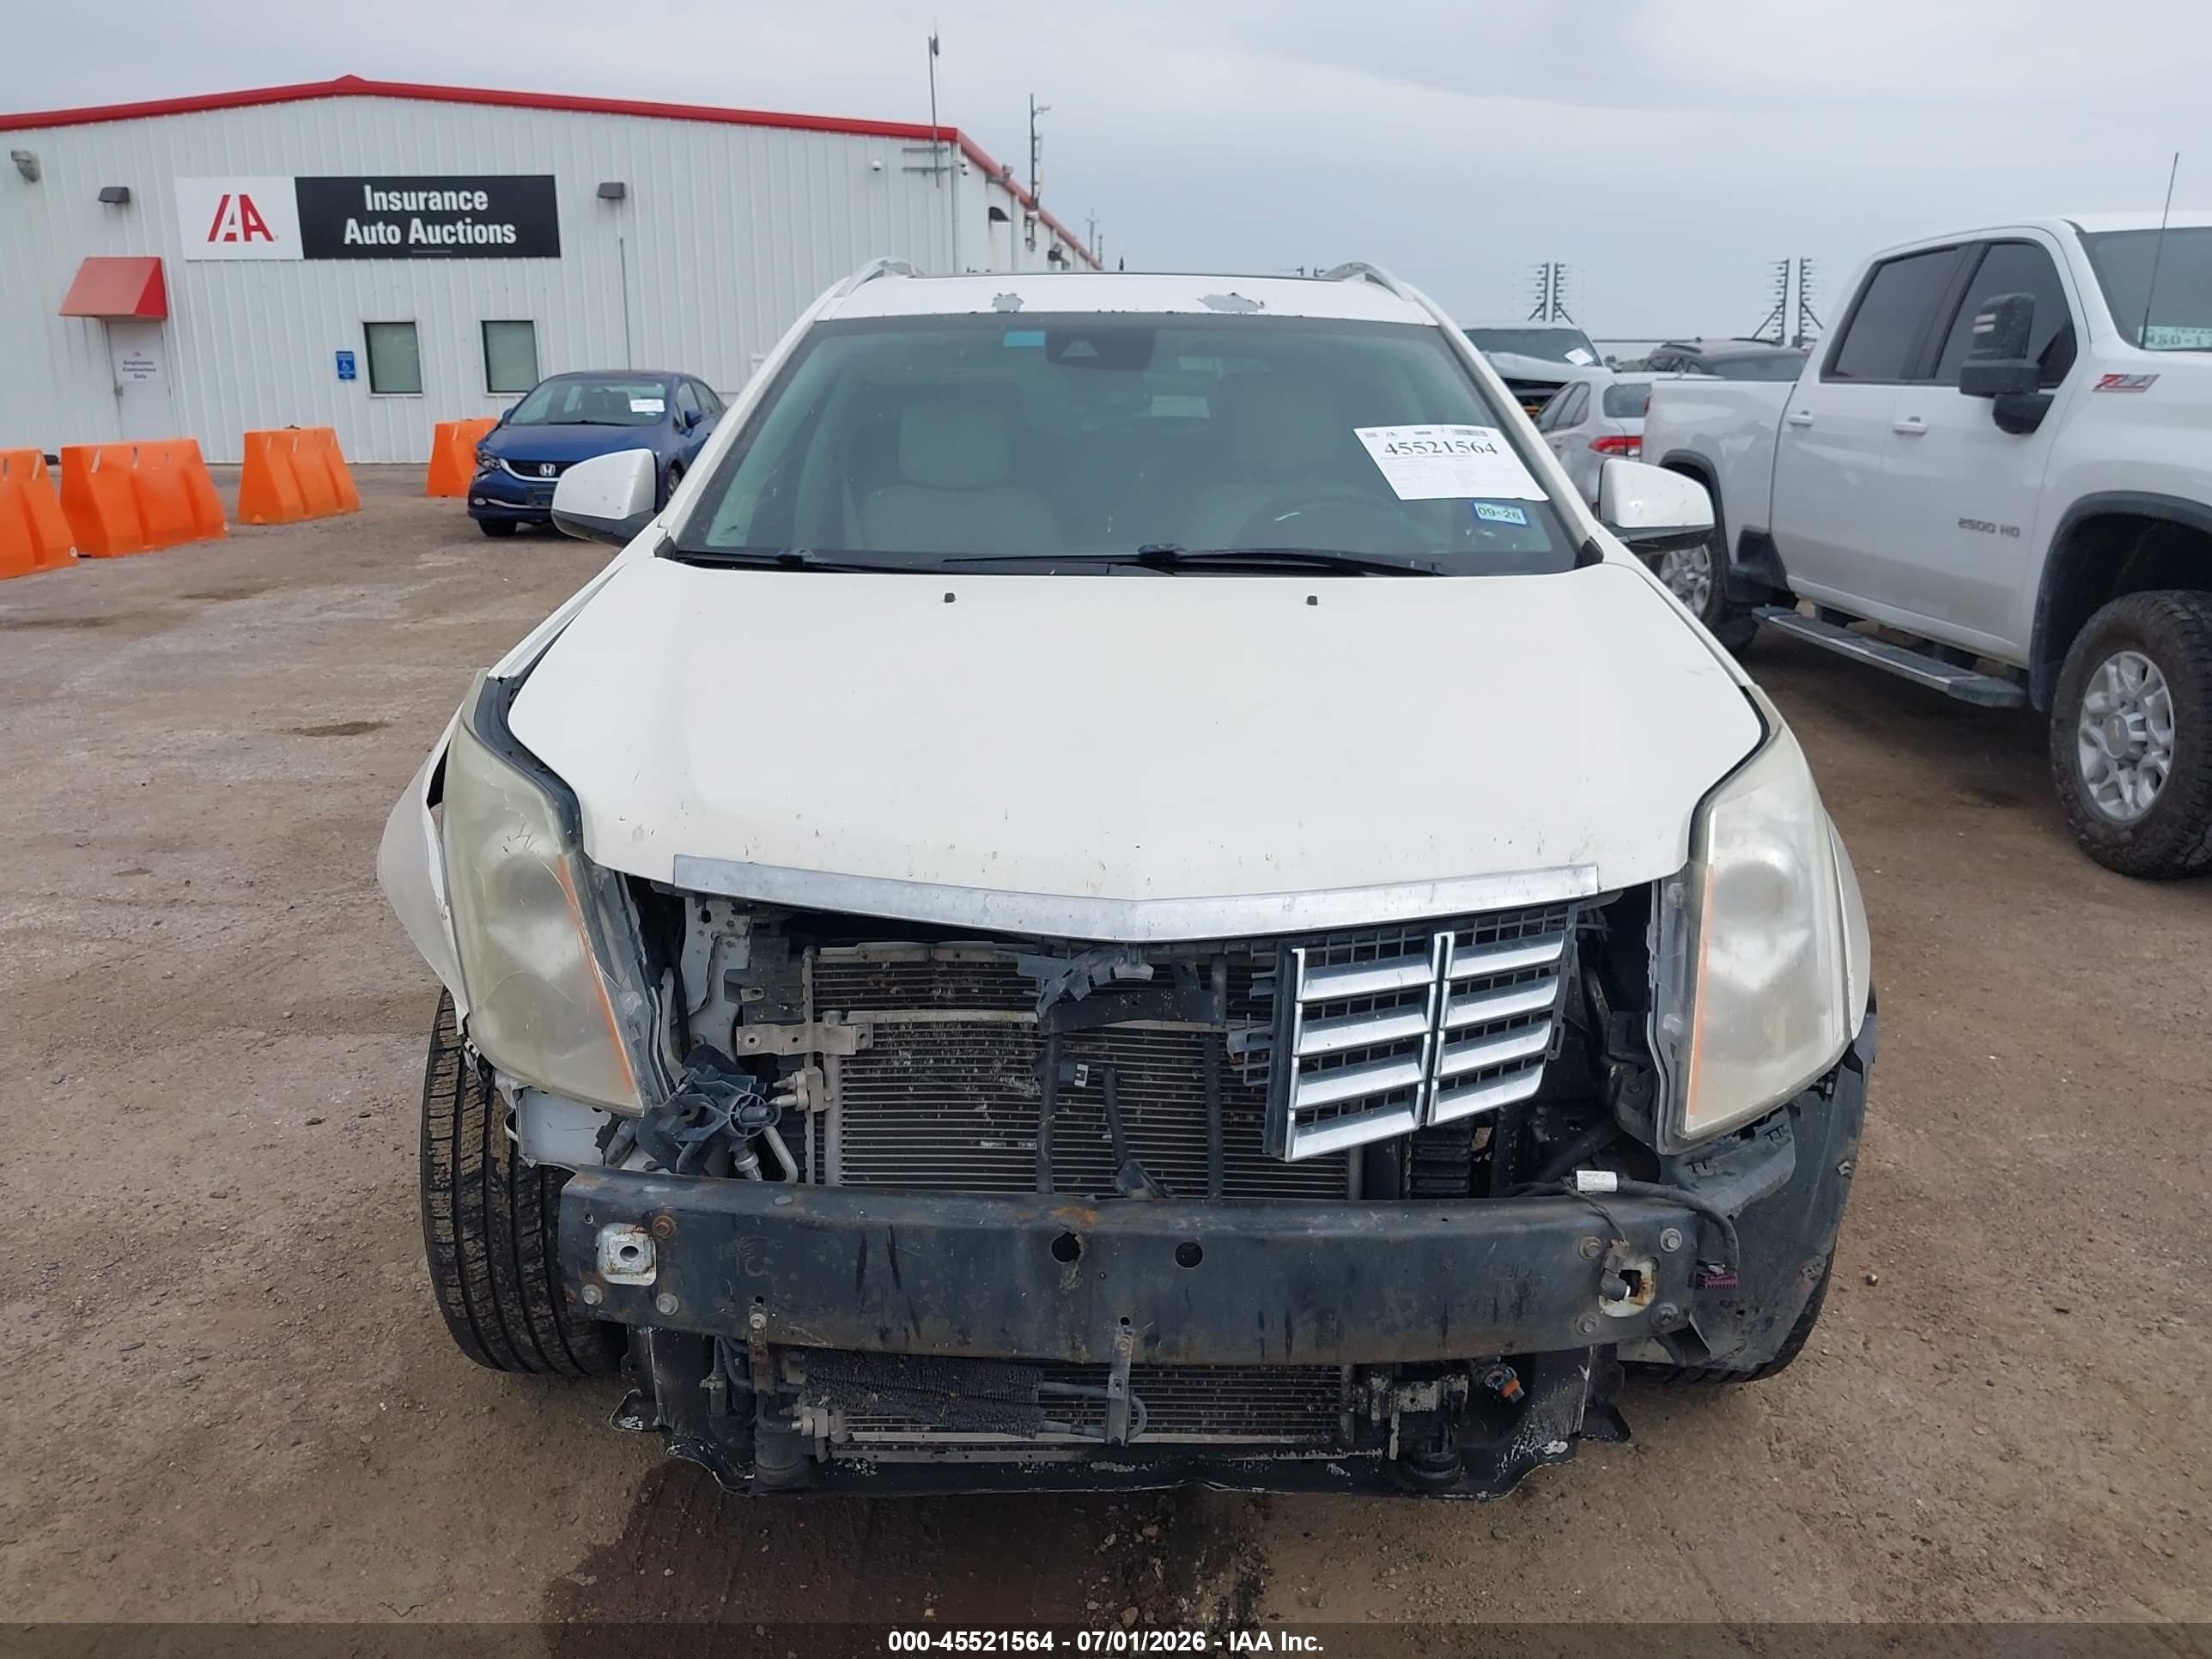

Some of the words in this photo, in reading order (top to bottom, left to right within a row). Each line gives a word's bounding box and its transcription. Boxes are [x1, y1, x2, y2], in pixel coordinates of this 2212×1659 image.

[364, 185, 489, 211] Insurance
[344, 218, 401, 245] Auto
[409, 217, 517, 245] Auctions
[1383, 441, 1498, 455] 45521564
[1957, 517, 1996, 534] 2500
[1999, 524, 2021, 538] HD
